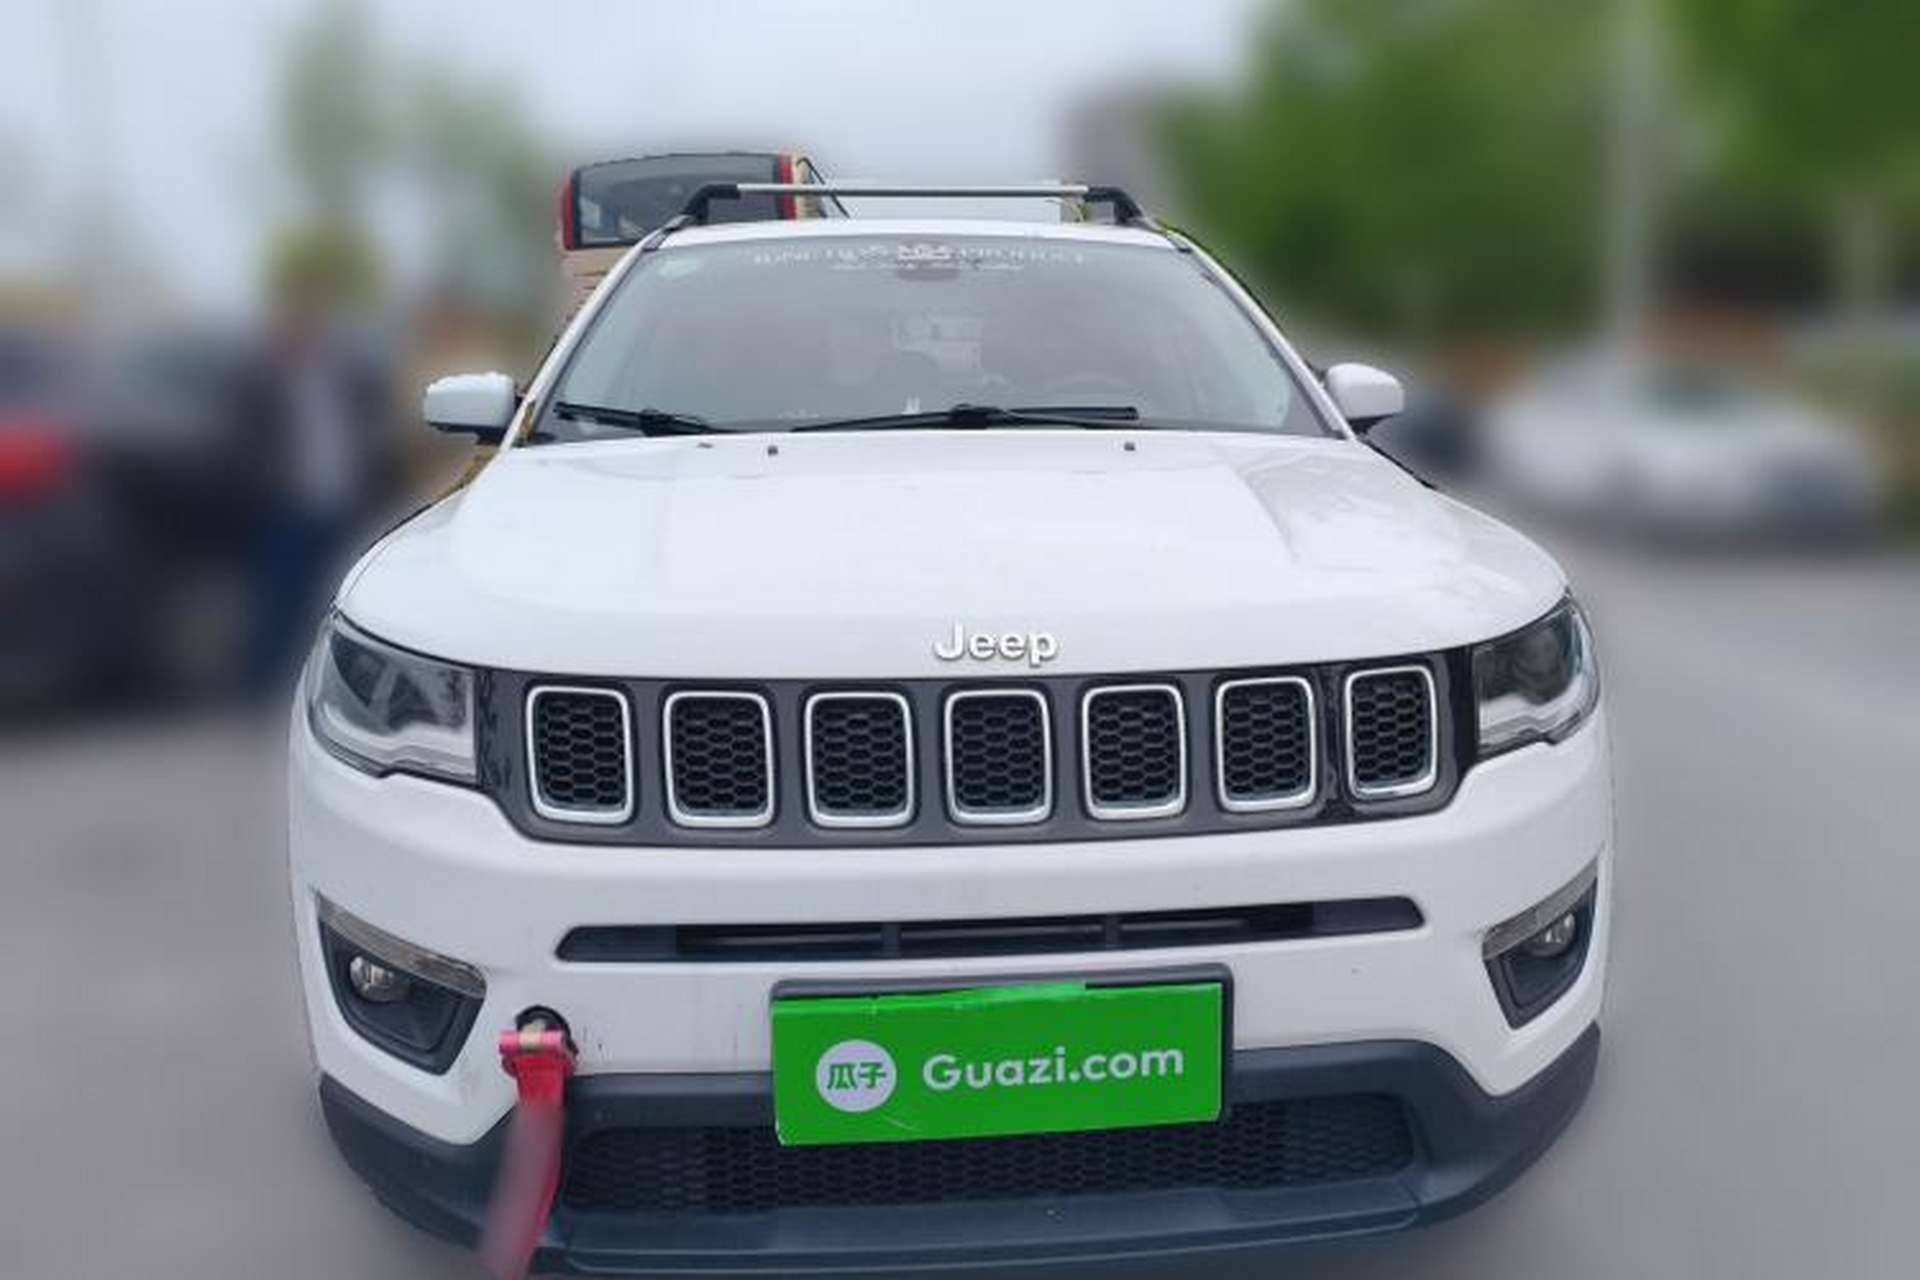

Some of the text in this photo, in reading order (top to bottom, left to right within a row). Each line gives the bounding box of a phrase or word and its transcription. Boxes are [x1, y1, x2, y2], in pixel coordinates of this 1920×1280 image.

[934, 622, 1057, 667] Jeep
[827, 1061, 887, 1090] 瓜子
[922, 1046, 1184, 1091] Guazi.com
